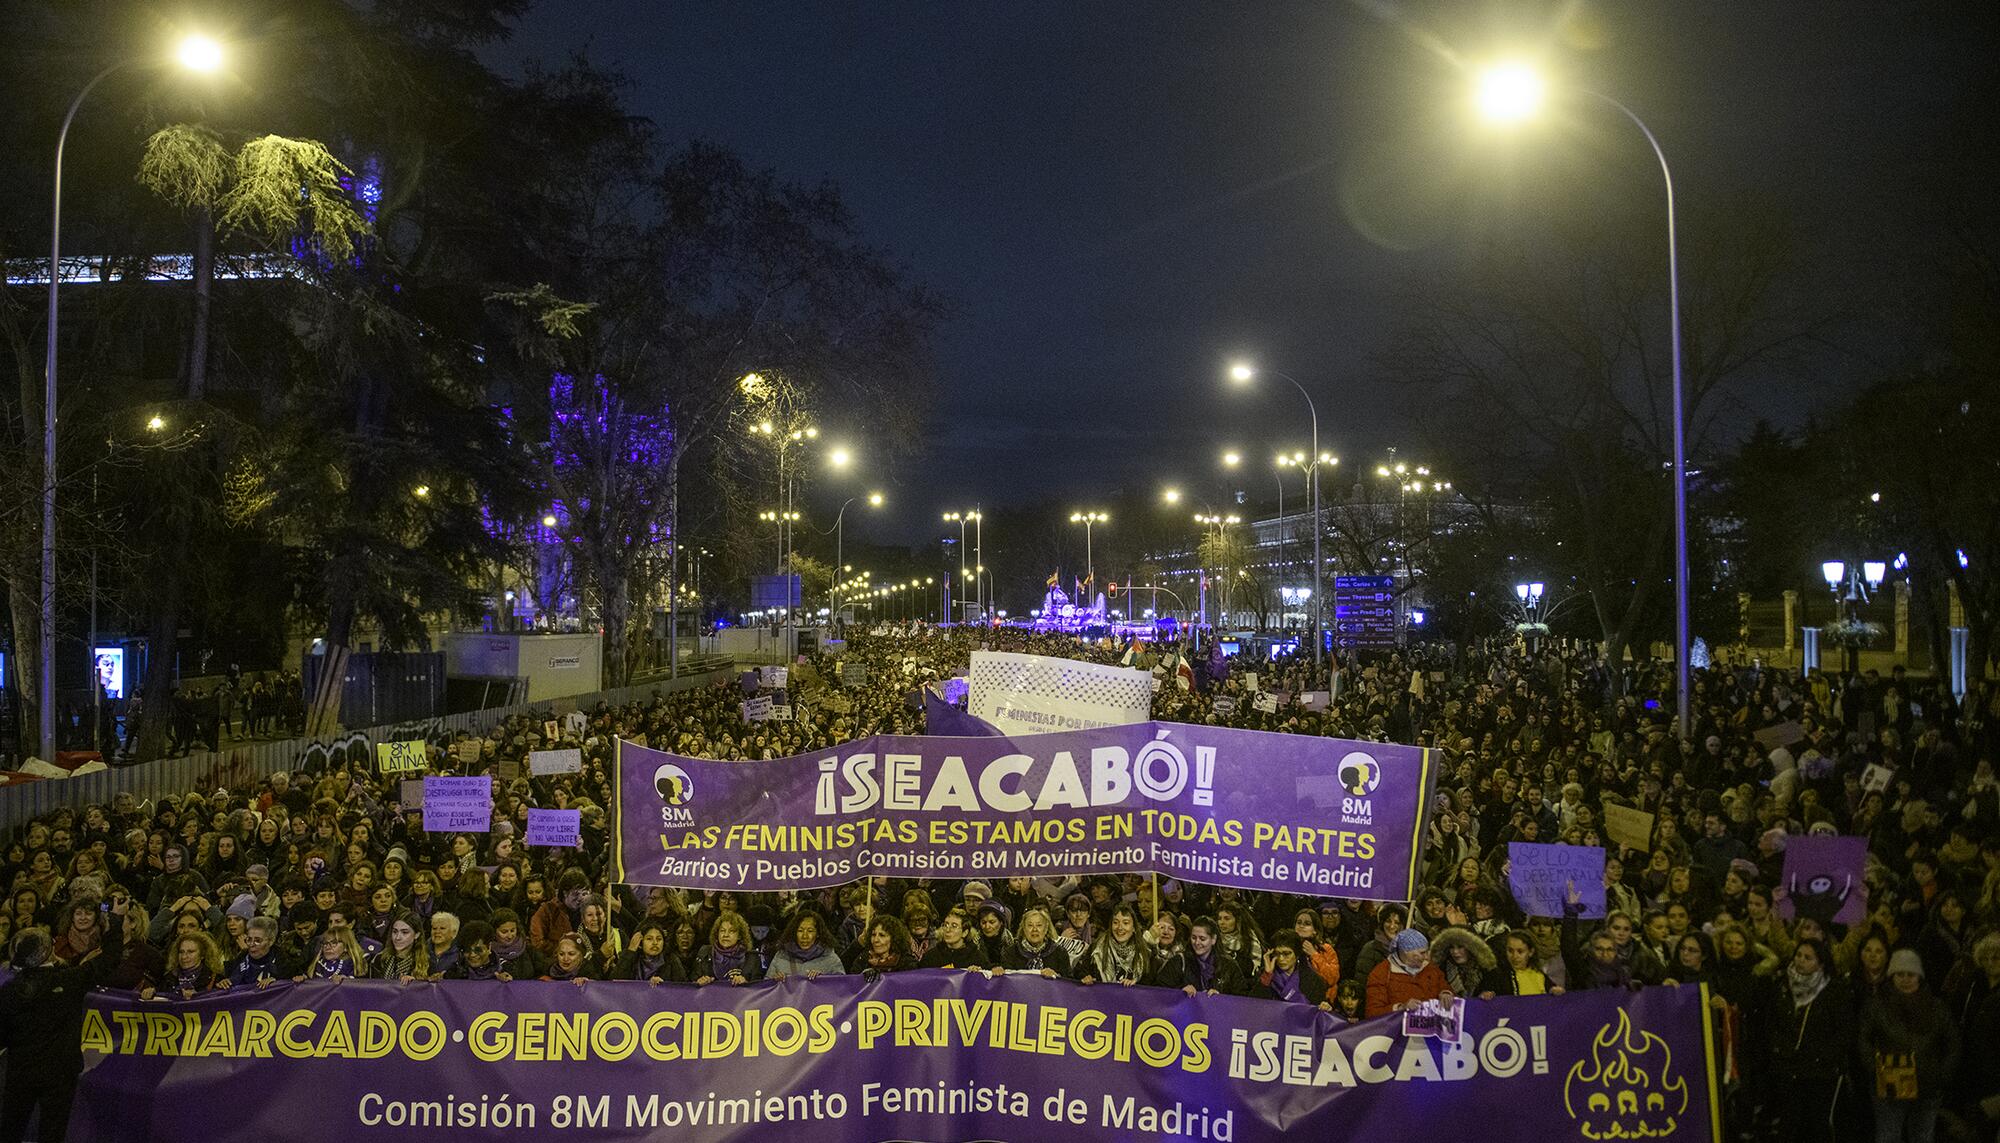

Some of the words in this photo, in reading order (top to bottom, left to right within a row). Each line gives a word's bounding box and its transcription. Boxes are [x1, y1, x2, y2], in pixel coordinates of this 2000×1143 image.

[1057, 715, 1082, 729] POR
[391, 741, 412, 757] 8M
[380, 753, 428, 773] LATINA
[815, 729, 1217, 815] ¡SEACABÓ!
[424, 788, 463, 798] DISTRUGGI
[464, 788, 484, 797] TUTTO
[661, 806, 693, 822] 8M
[1341, 796, 1373, 816] 8M
[663, 820, 696, 829] Madrid
[1341, 813, 1373, 826] Madrid
[556, 825, 576, 833] LIBRE
[660, 825, 722, 851] LAS
[723, 818, 920, 853] FEMINISTAS
[928, 818, 1087, 845] ESTAMOS
[1095, 812, 1134, 841] EN
[1141, 808, 1244, 847] TODAS
[1253, 822, 1377, 860] PARTES
[659, 856, 732, 879] Barrios
[736, 863, 750, 885] y
[755, 858, 852, 881] Pueblos
[856, 848, 965, 871] Comisión
[970, 850, 1008, 870] 8M
[1014, 846, 1146, 870] Movimiento
[1150, 842, 1255, 878] Feminista
[1260, 857, 1290, 881] de
[1295, 861, 1374, 889] Madrid
[1545, 849, 1570, 867] LO
[80, 1008, 447, 1062] ATRIARCADO
[467, 1004, 838, 1062] GENOCIDIOS
[856, 998, 1213, 1074] PRIVILEGIOS
[1228, 1017, 1550, 1088] ¡SEACABÓ!
[358, 1091, 536, 1128] Comisión
[550, 1094, 611, 1128] 8M
[624, 1089, 849, 1128] Movimiento
[861, 1080, 1030, 1118] Feminista
[1042, 1088, 1089, 1126] de
[1101, 1094, 1234, 1143] Madrid
